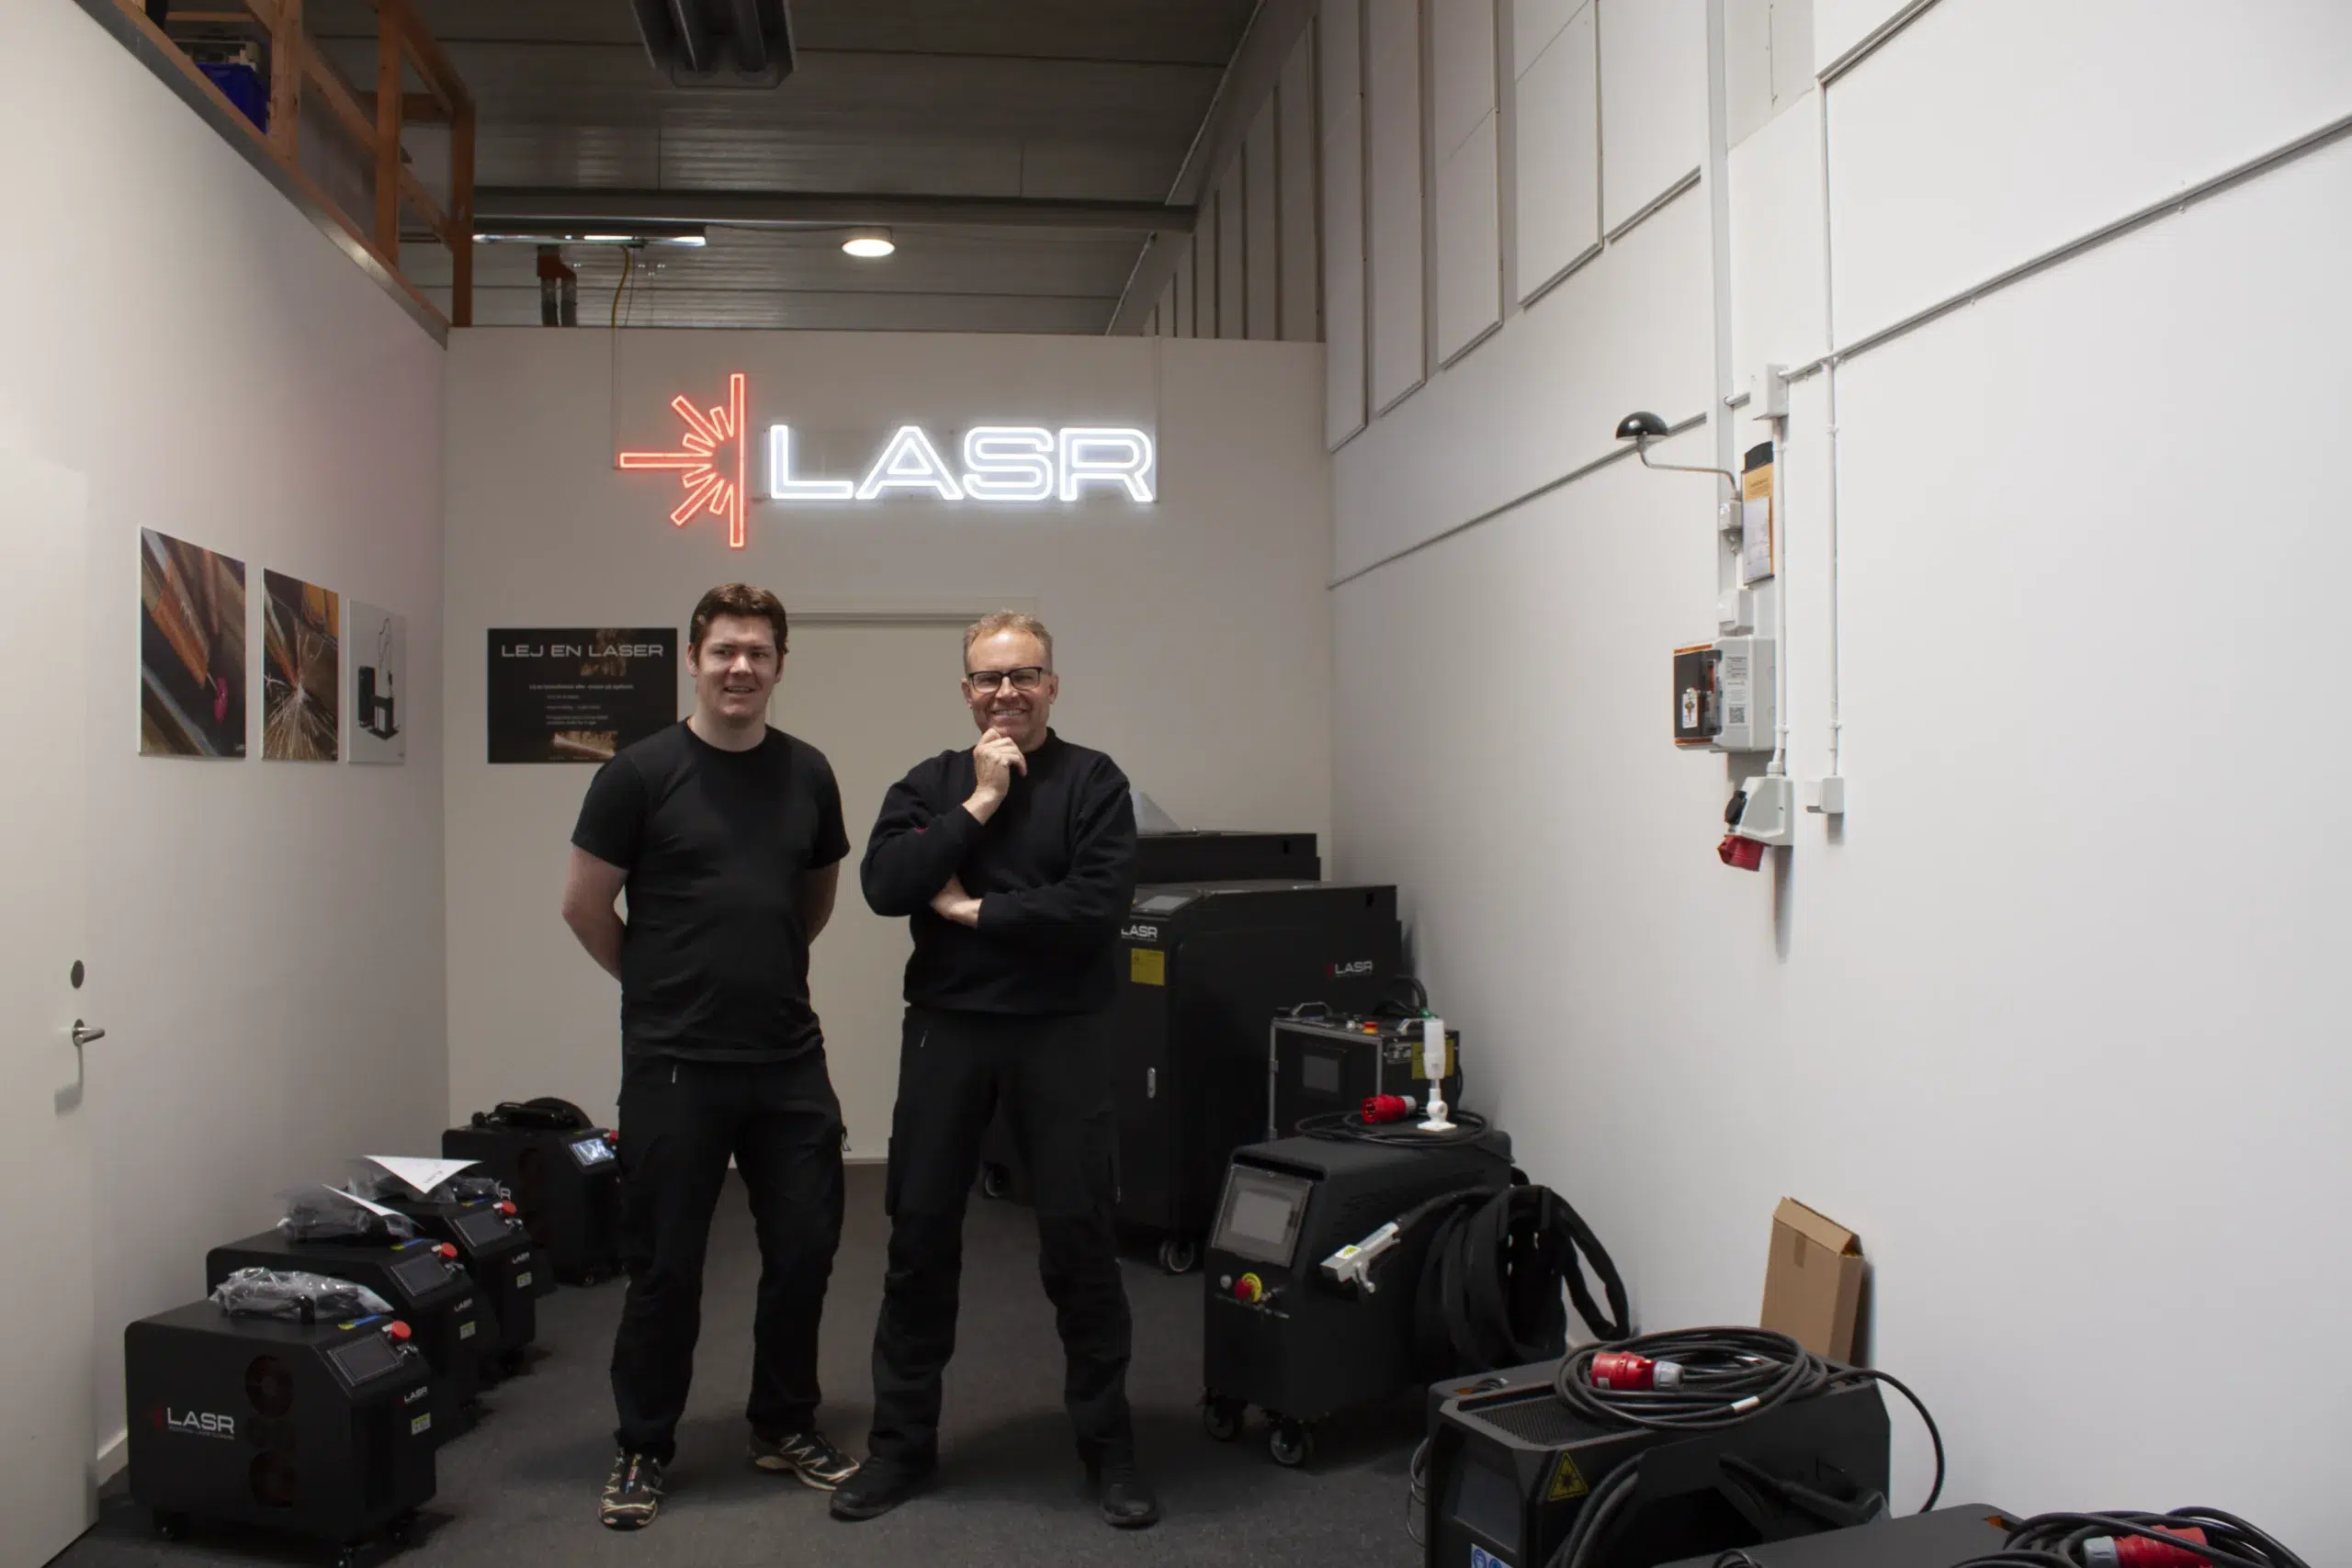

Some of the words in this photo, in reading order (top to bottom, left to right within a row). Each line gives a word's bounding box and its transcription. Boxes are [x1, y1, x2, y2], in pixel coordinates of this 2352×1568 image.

[769, 423, 1156, 502] LASR
[501, 645, 544, 658] LEJ
[550, 645, 582, 658] EN
[588, 645, 664, 658] LASER
[1121, 925, 1158, 938] LASR
[1335, 961, 1373, 974] LASR
[404, 1386, 427, 1404] LASR
[166, 1406, 235, 1435] LASR
